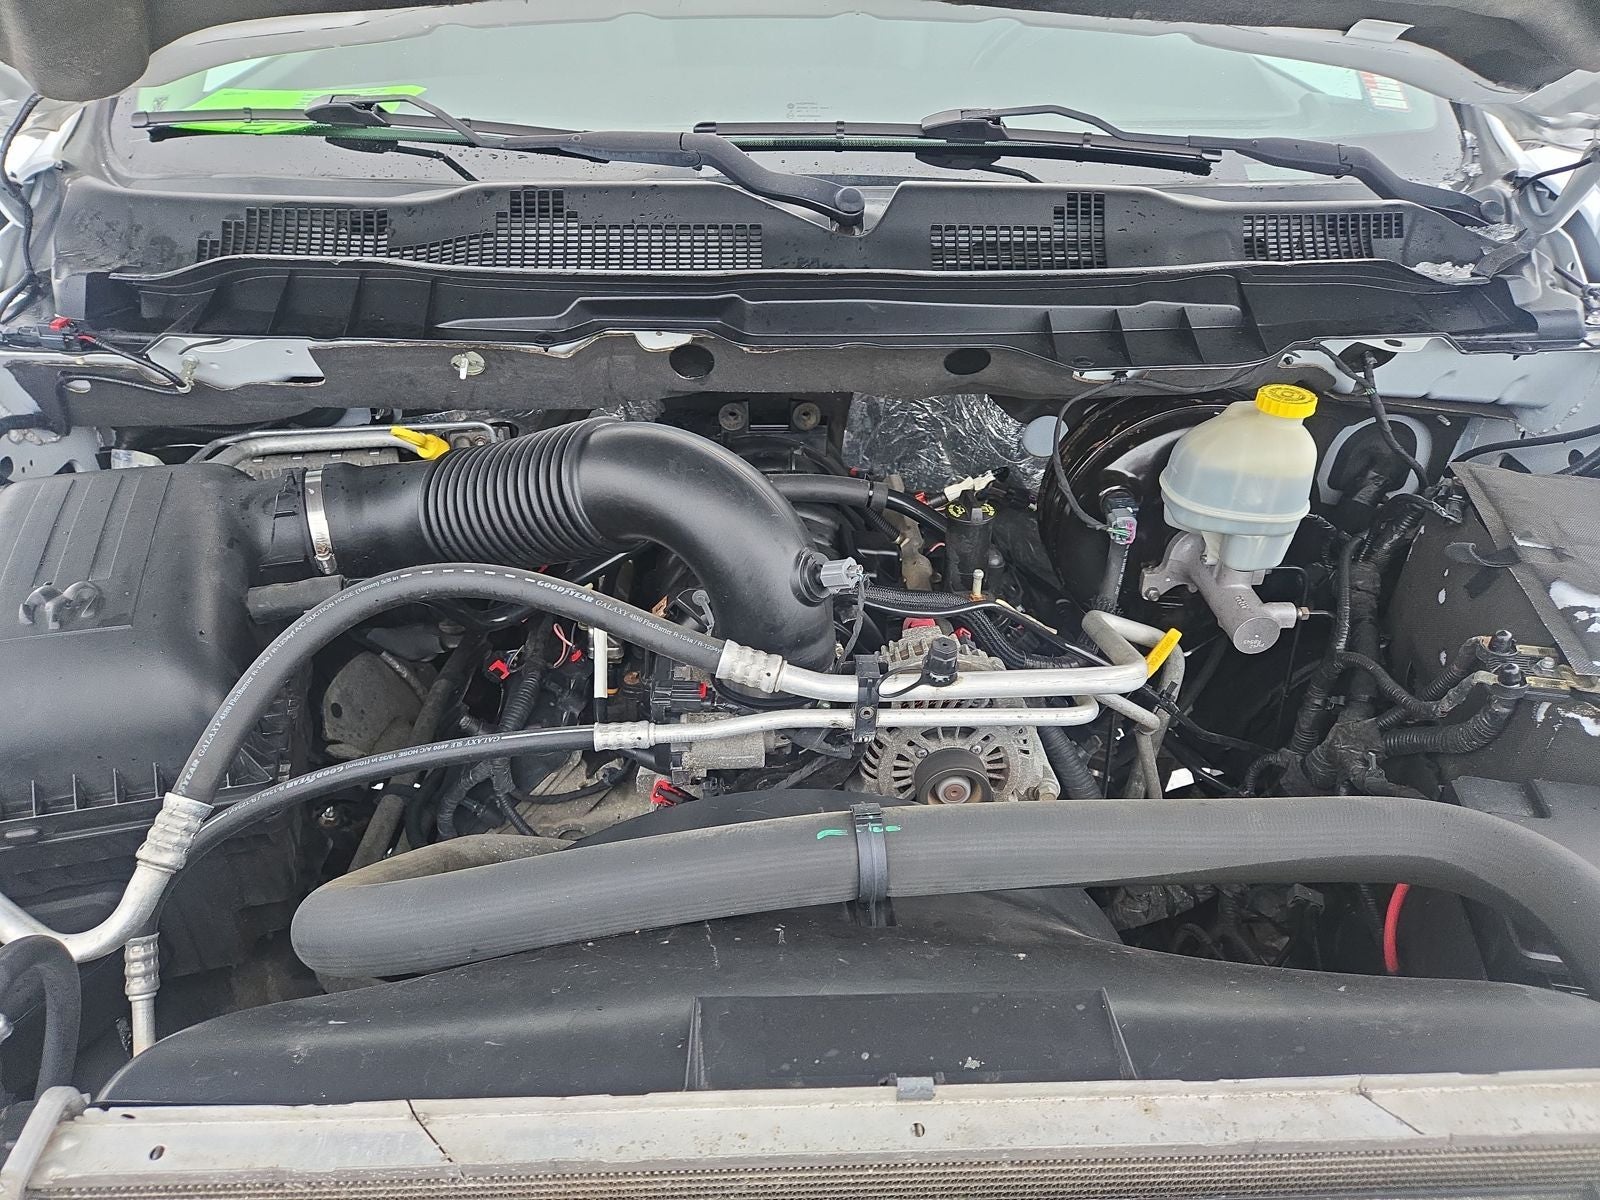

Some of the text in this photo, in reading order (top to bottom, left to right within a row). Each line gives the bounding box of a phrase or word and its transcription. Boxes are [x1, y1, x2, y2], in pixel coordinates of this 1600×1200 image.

[536, 580, 594, 602] GOODYEAR
[595, 599, 631, 618] GALAXY
[642, 618, 674, 636] FlexBarrier
[198, 720, 221, 757] GALAXY
[304, 601, 335, 624] SUCTION
[333, 589, 355, 605] HOSE
[397, 749, 419, 759] HOSE
[464, 735, 500, 748] GALAXY
[285, 765, 345, 790] GOODYEAR
